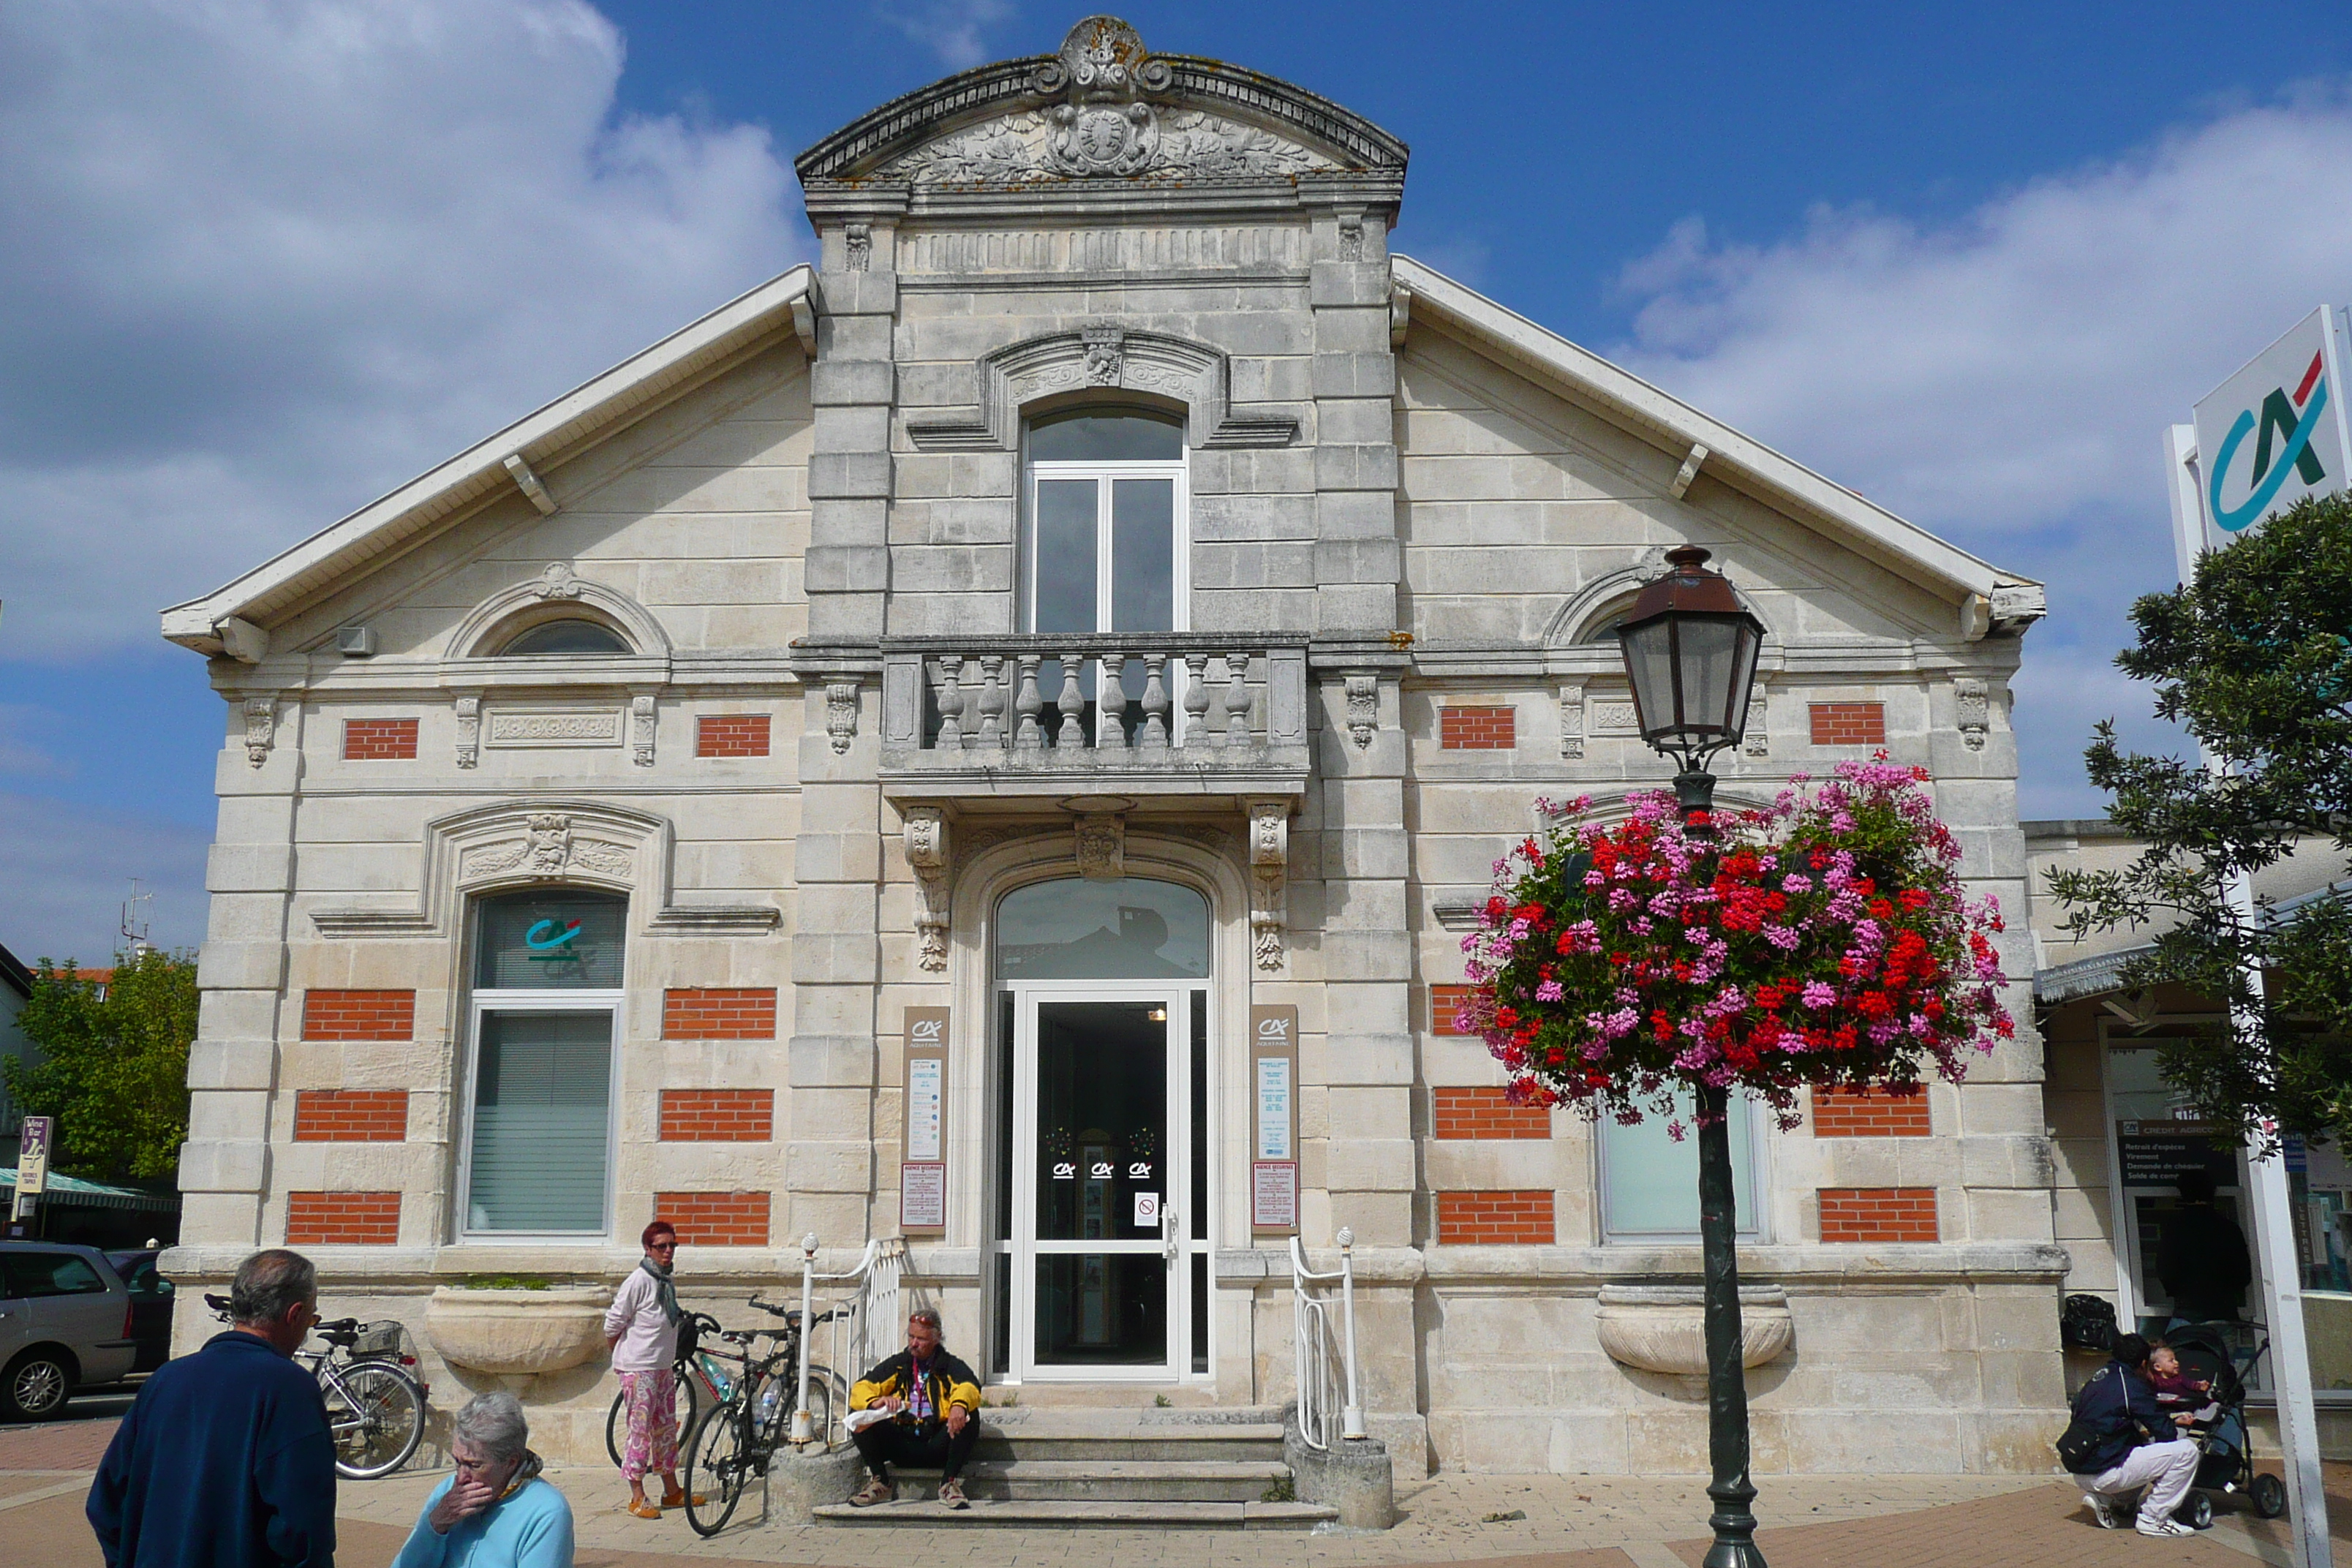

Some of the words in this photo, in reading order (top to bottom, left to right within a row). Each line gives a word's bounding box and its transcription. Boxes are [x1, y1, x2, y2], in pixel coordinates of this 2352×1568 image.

[1080, 109, 1124, 155] CHARLOTTE
[26, 1119, 44, 1128] Wine
[29, 1128, 42, 1137] Bar
[2299, 1205, 2311, 1262] LETTRES
